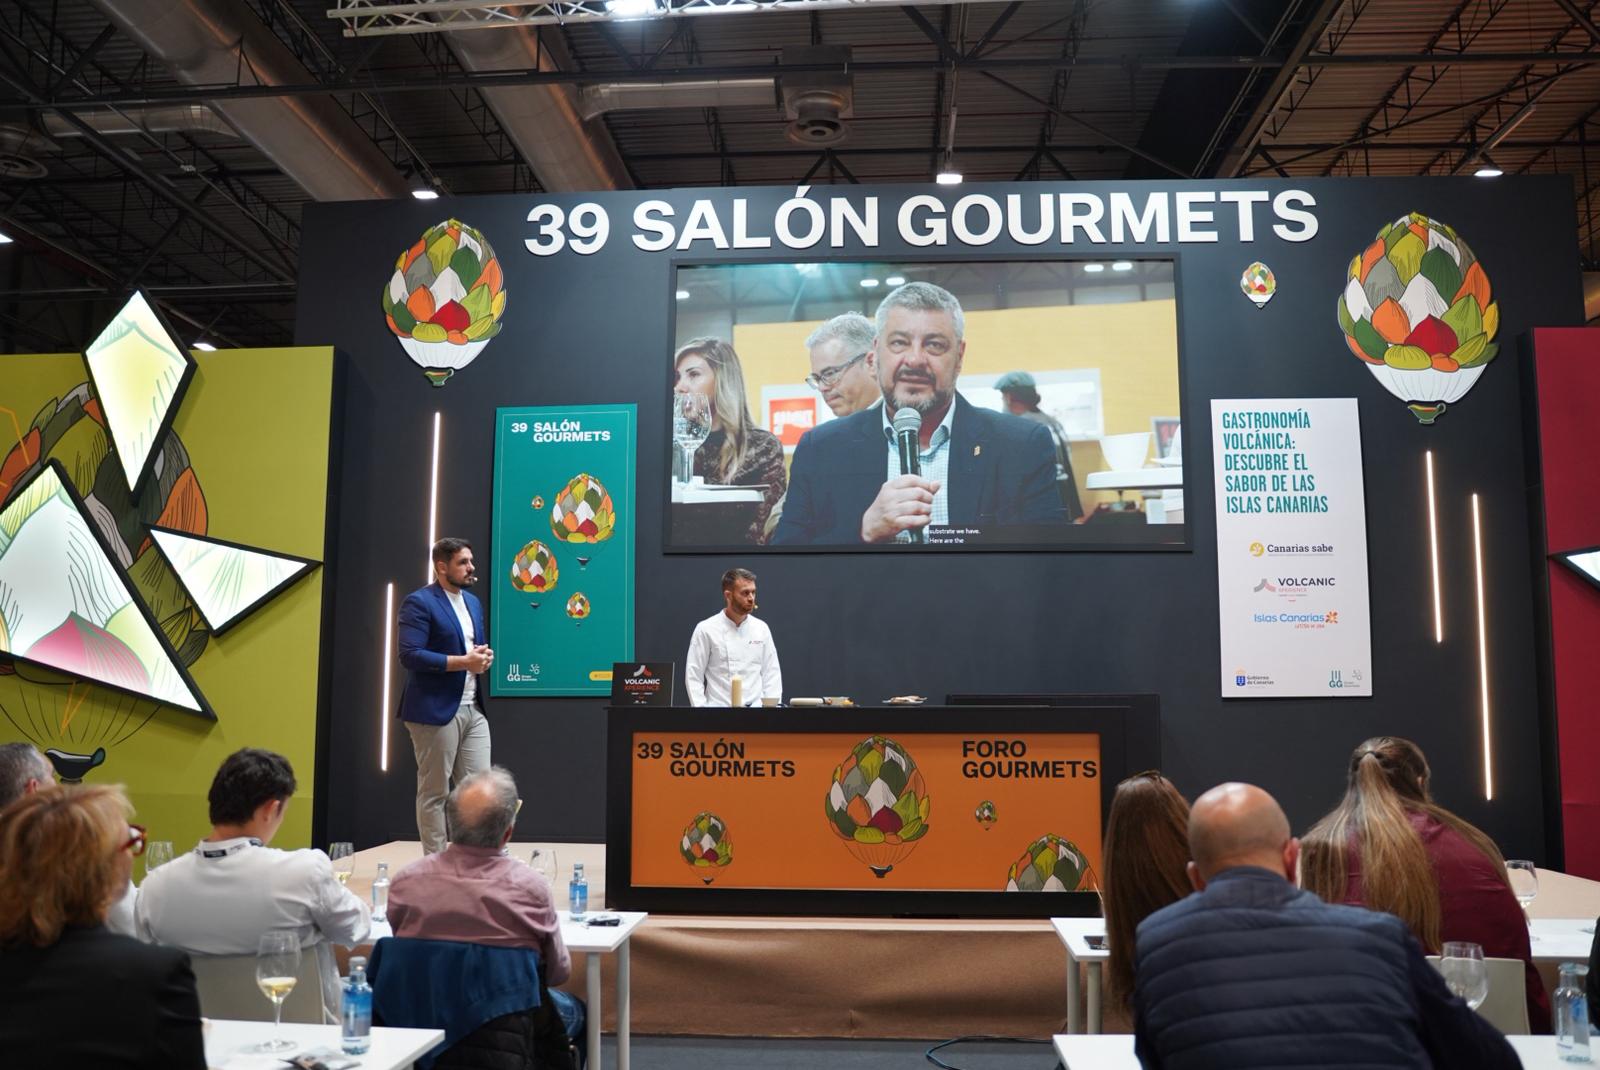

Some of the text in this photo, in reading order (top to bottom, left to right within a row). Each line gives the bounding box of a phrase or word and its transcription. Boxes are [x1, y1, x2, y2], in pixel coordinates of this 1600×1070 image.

[524, 185, 1320, 256] 39 SALÓN GOURMETS
[511, 419, 581, 433] 39 SALÓN
[1222, 408, 1311, 429] GASTRONOMÍA
[533, 431, 611, 443] GOURMETS
[1223, 429, 1296, 450] VOLCÁNICA:
[1224, 453, 1309, 471] DESCUBRE EL
[1225, 474, 1315, 492] SABOR DE LAS
[1226, 495, 1329, 513] ISLAS CANARIAS
[1267, 543, 1334, 553] Canarias sabe
[1278, 577, 1335, 586] VOLCANIC
[1254, 613, 1325, 623] Islas Canarias
[637, 737, 745, 760] 39 SALÓN
[962, 740, 1026, 759] FORO
[669, 760, 796, 778] GOURMETS
[962, 760, 1098, 779] GOURMETS
